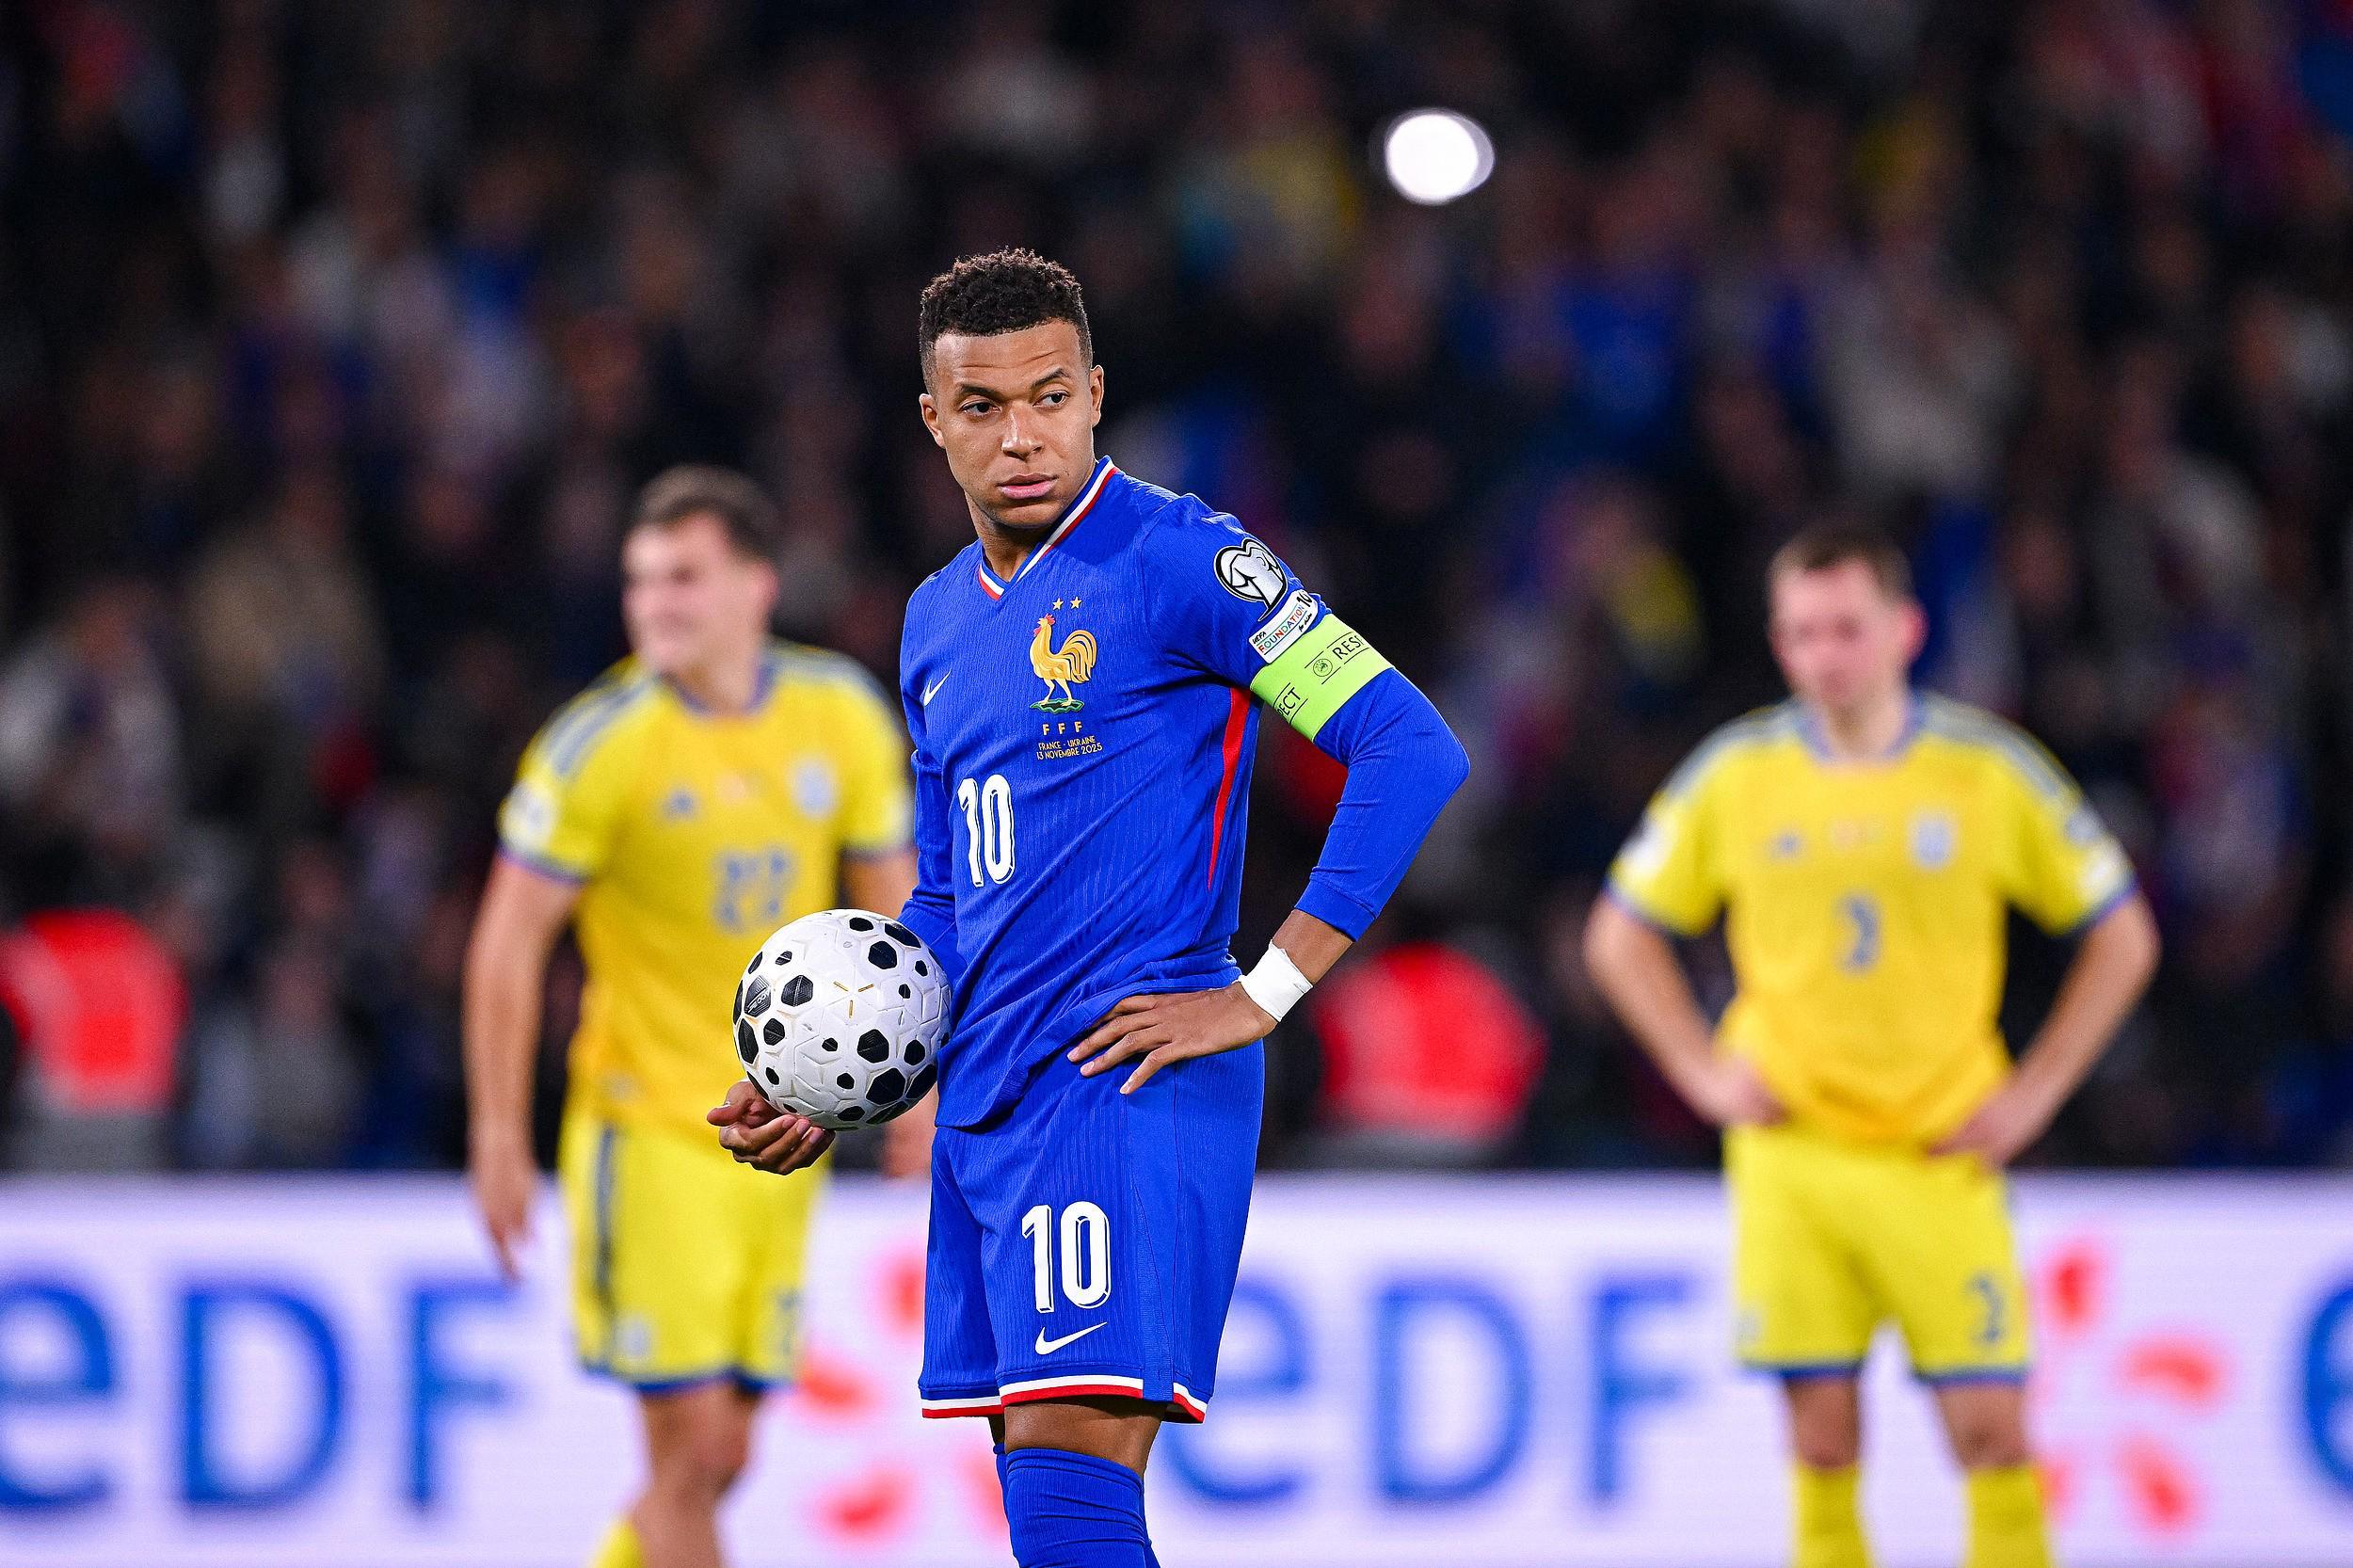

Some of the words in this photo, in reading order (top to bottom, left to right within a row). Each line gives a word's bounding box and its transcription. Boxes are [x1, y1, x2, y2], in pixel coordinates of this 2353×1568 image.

[1257, 604, 1305, 653] FOUNDATION
[1036, 751, 1044, 760] 13
[1045, 747, 1080, 760] NOVEMBRE
[1080, 743, 1103, 755] 2025
[1038, 741, 1062, 751] FRANCE
[1066, 735, 1096, 748] UKRAINE
[957, 774, 1016, 888] 10
[1021, 1200, 1112, 1314] 10
